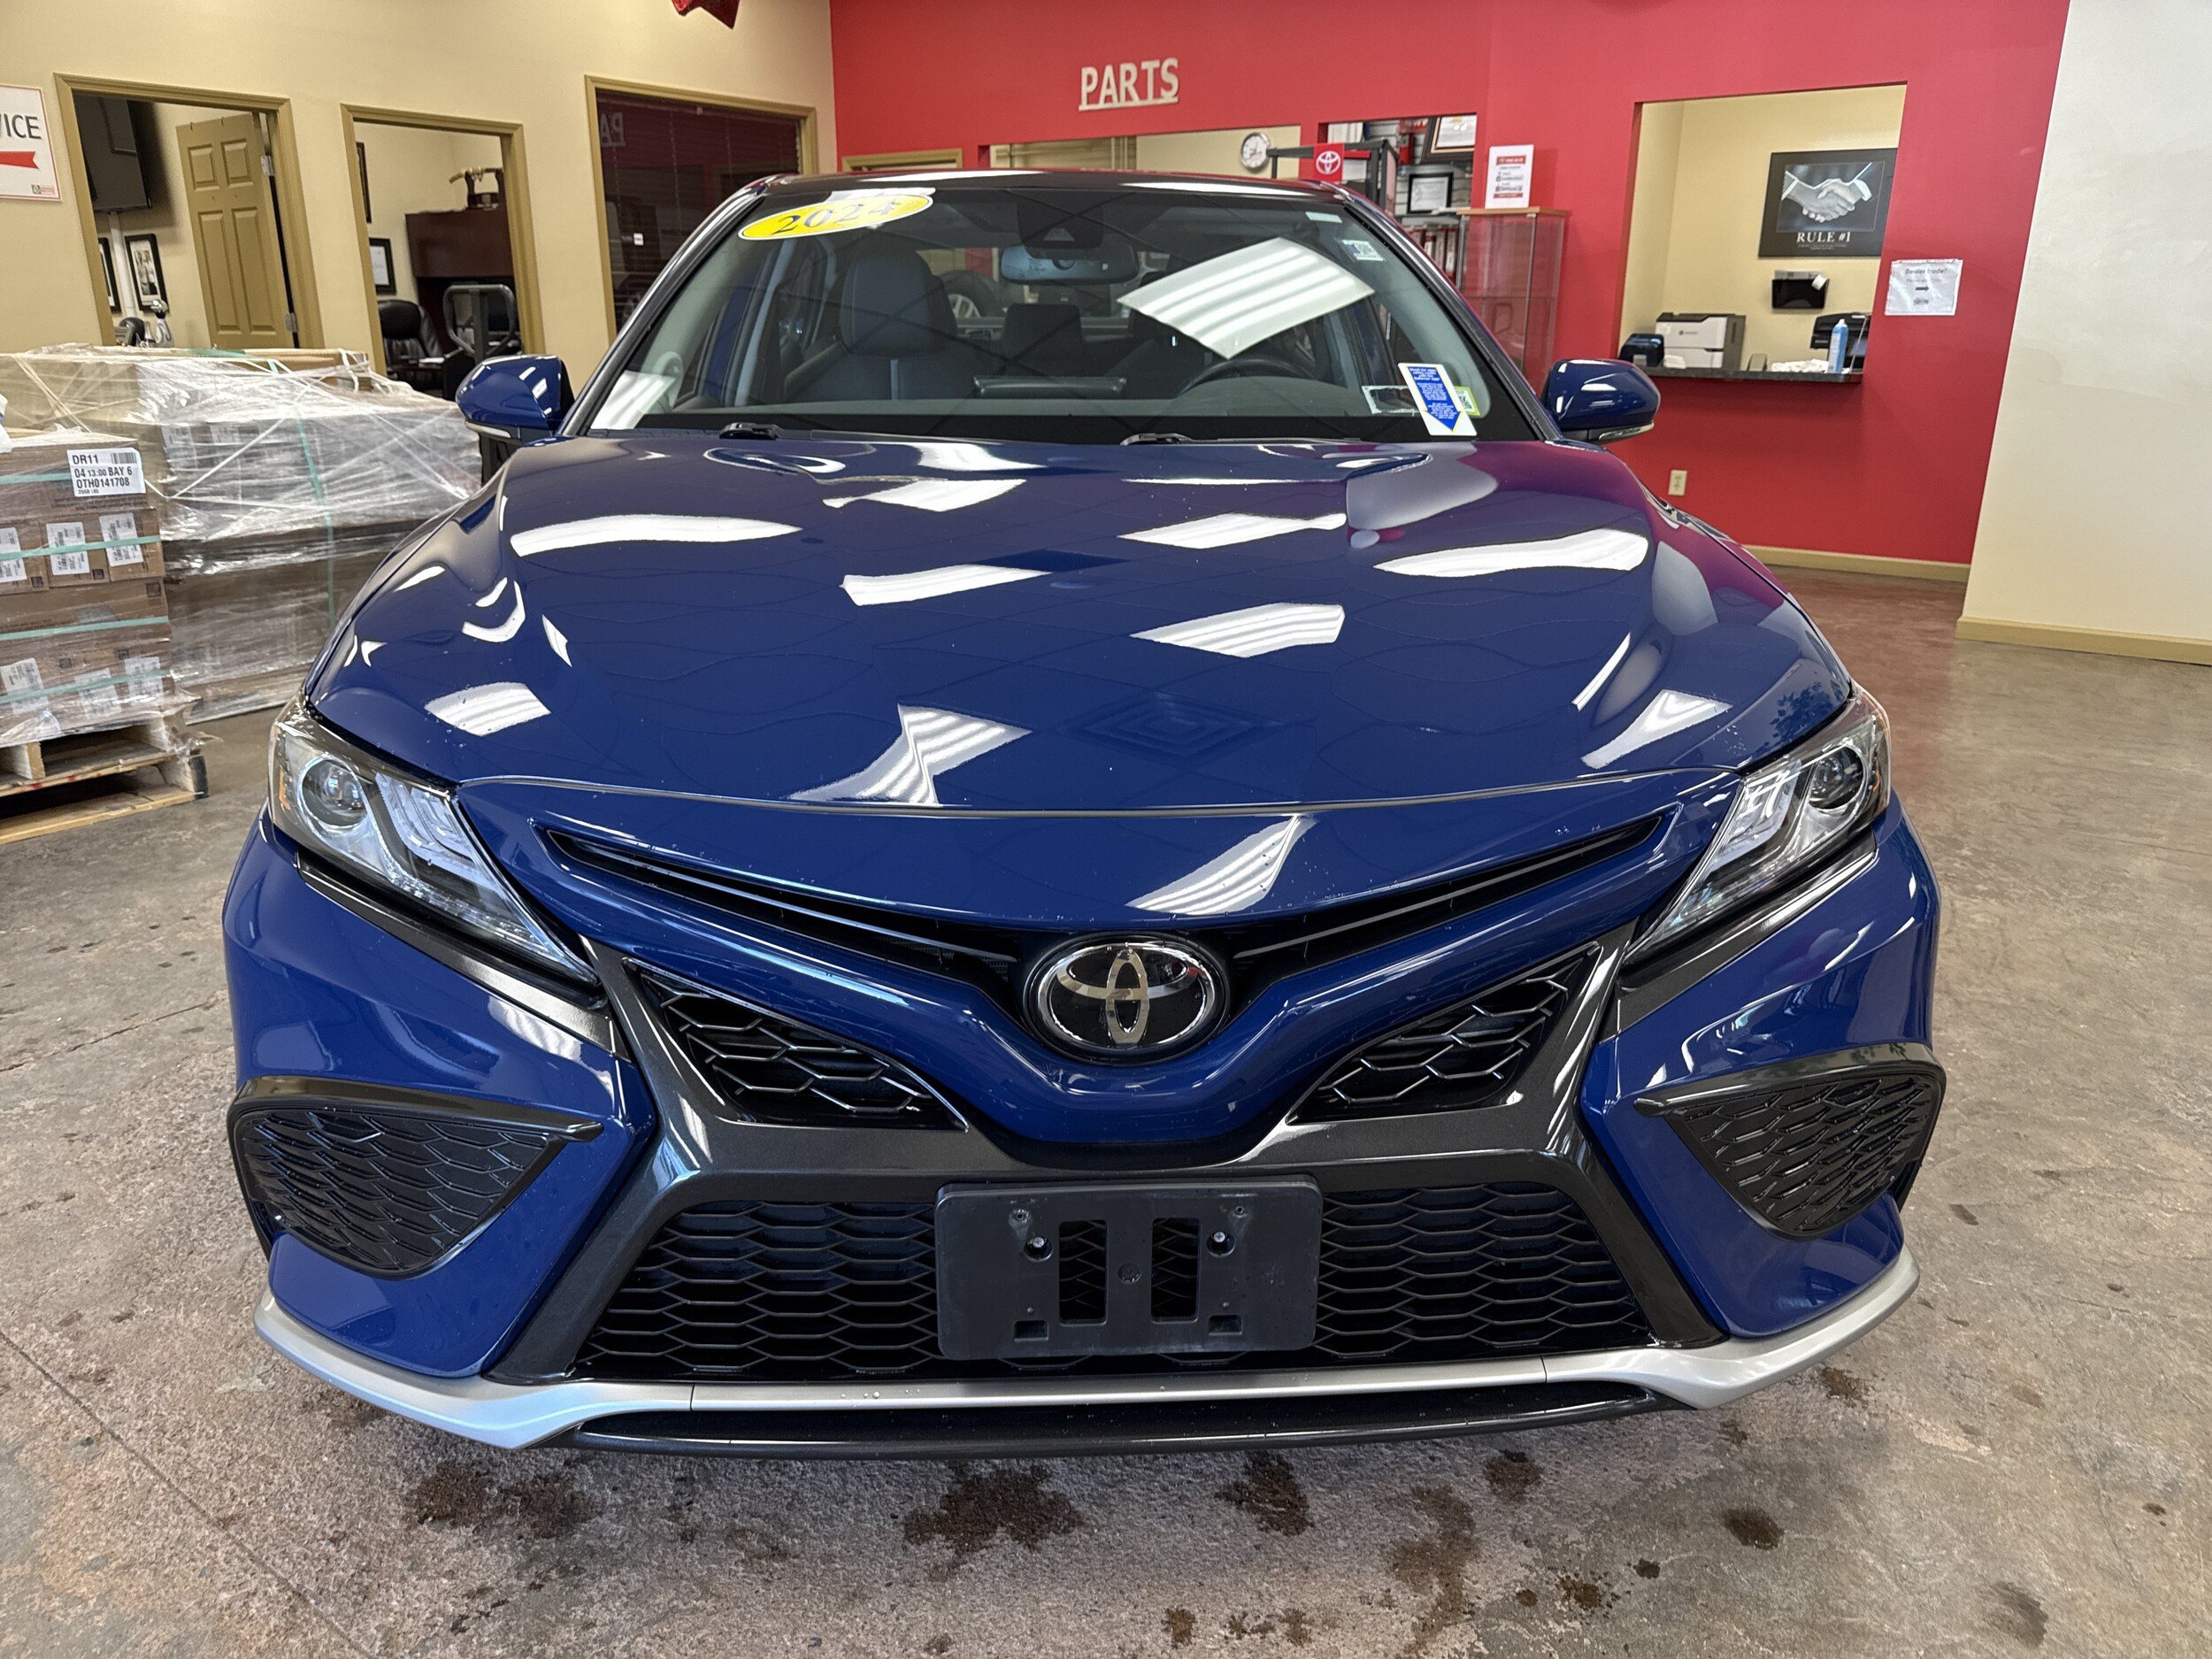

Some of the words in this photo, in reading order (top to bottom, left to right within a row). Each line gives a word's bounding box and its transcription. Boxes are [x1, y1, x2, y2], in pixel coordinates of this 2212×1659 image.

[1080, 58, 1179, 106] PARTS
[0, 112, 42, 140] ICE
[771, 200, 902, 235] 2024
[1796, 231, 1835, 242] RULE
[1839, 231, 1851, 242] #1
[72, 454, 99, 465] DR11
[74, 468, 86, 478] 04
[107, 466, 125, 476] BAY
[127, 466, 133, 475] 6
